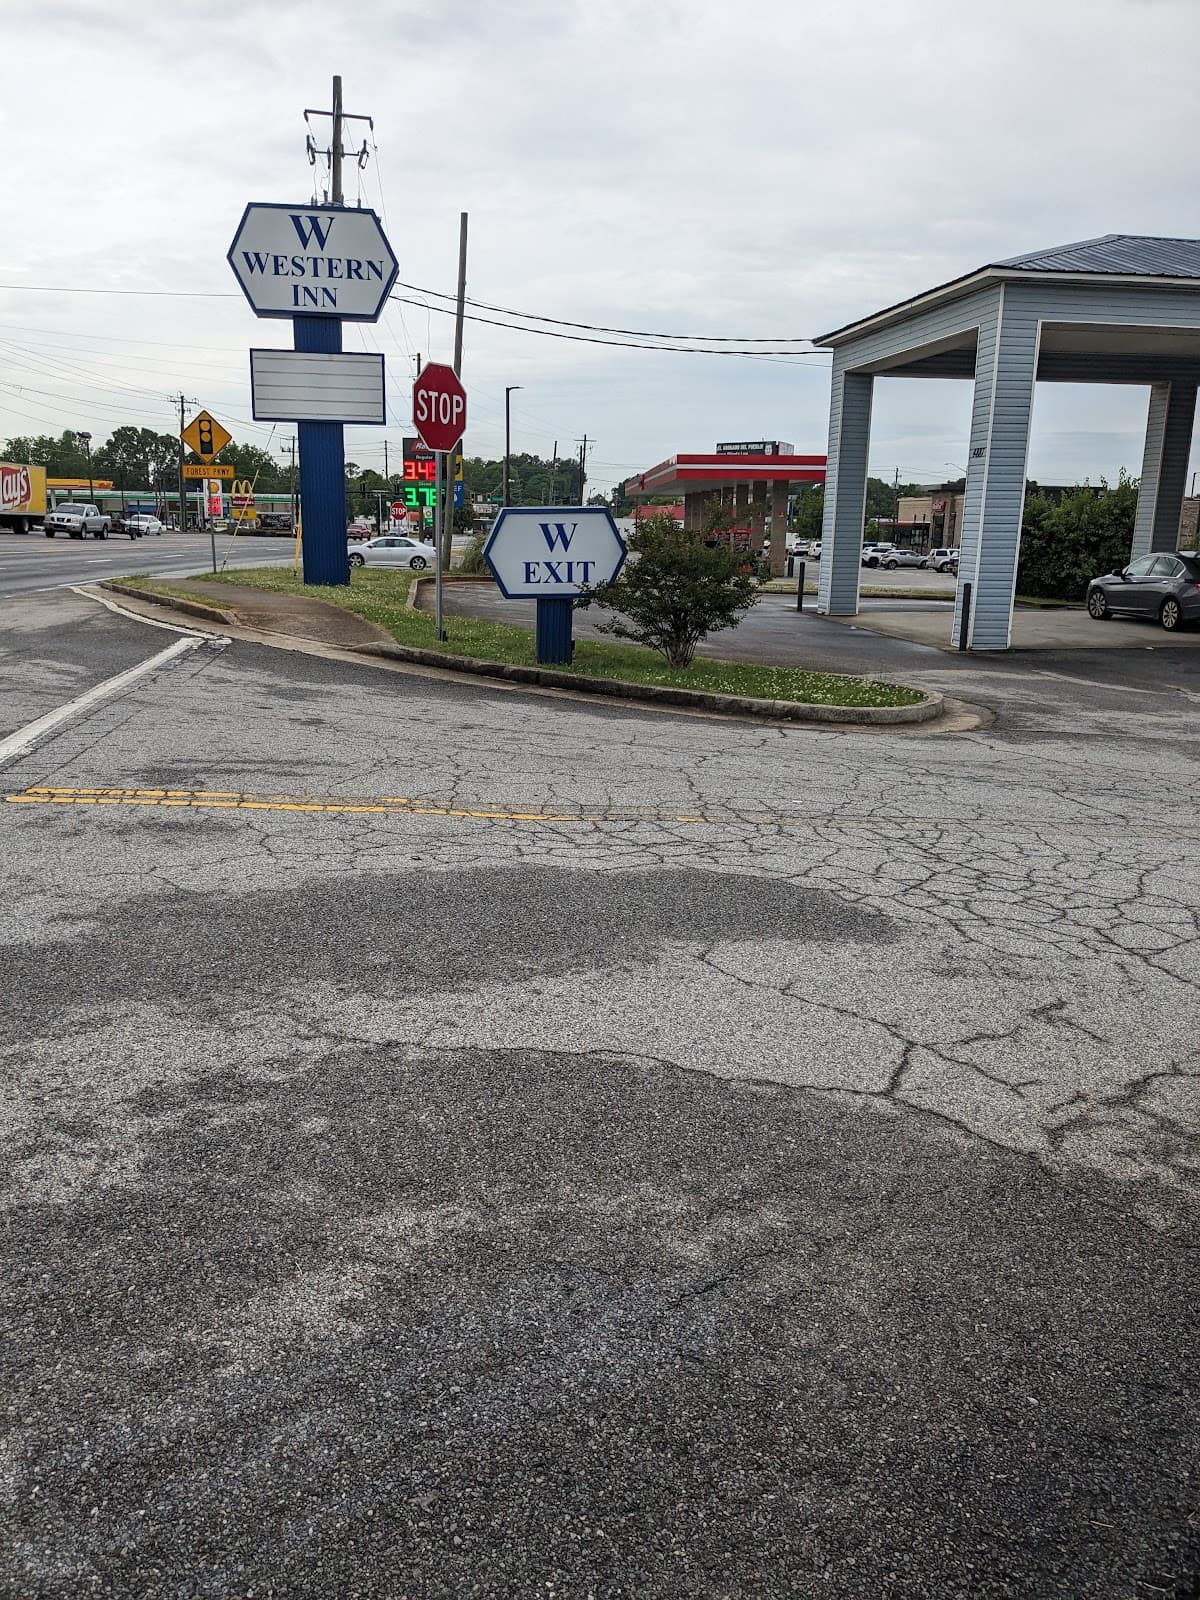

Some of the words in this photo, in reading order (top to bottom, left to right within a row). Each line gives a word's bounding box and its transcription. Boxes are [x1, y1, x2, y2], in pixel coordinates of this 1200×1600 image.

[288, 215, 336, 252] W
[242, 251, 384, 281] WESTERN
[291, 284, 338, 308] INN
[417, 389, 464, 426] STOP
[186, 467, 210, 476] FOREST
[391, 508, 407, 516] STOP
[538, 523, 578, 553] W
[522, 561, 596, 584] EXIT
